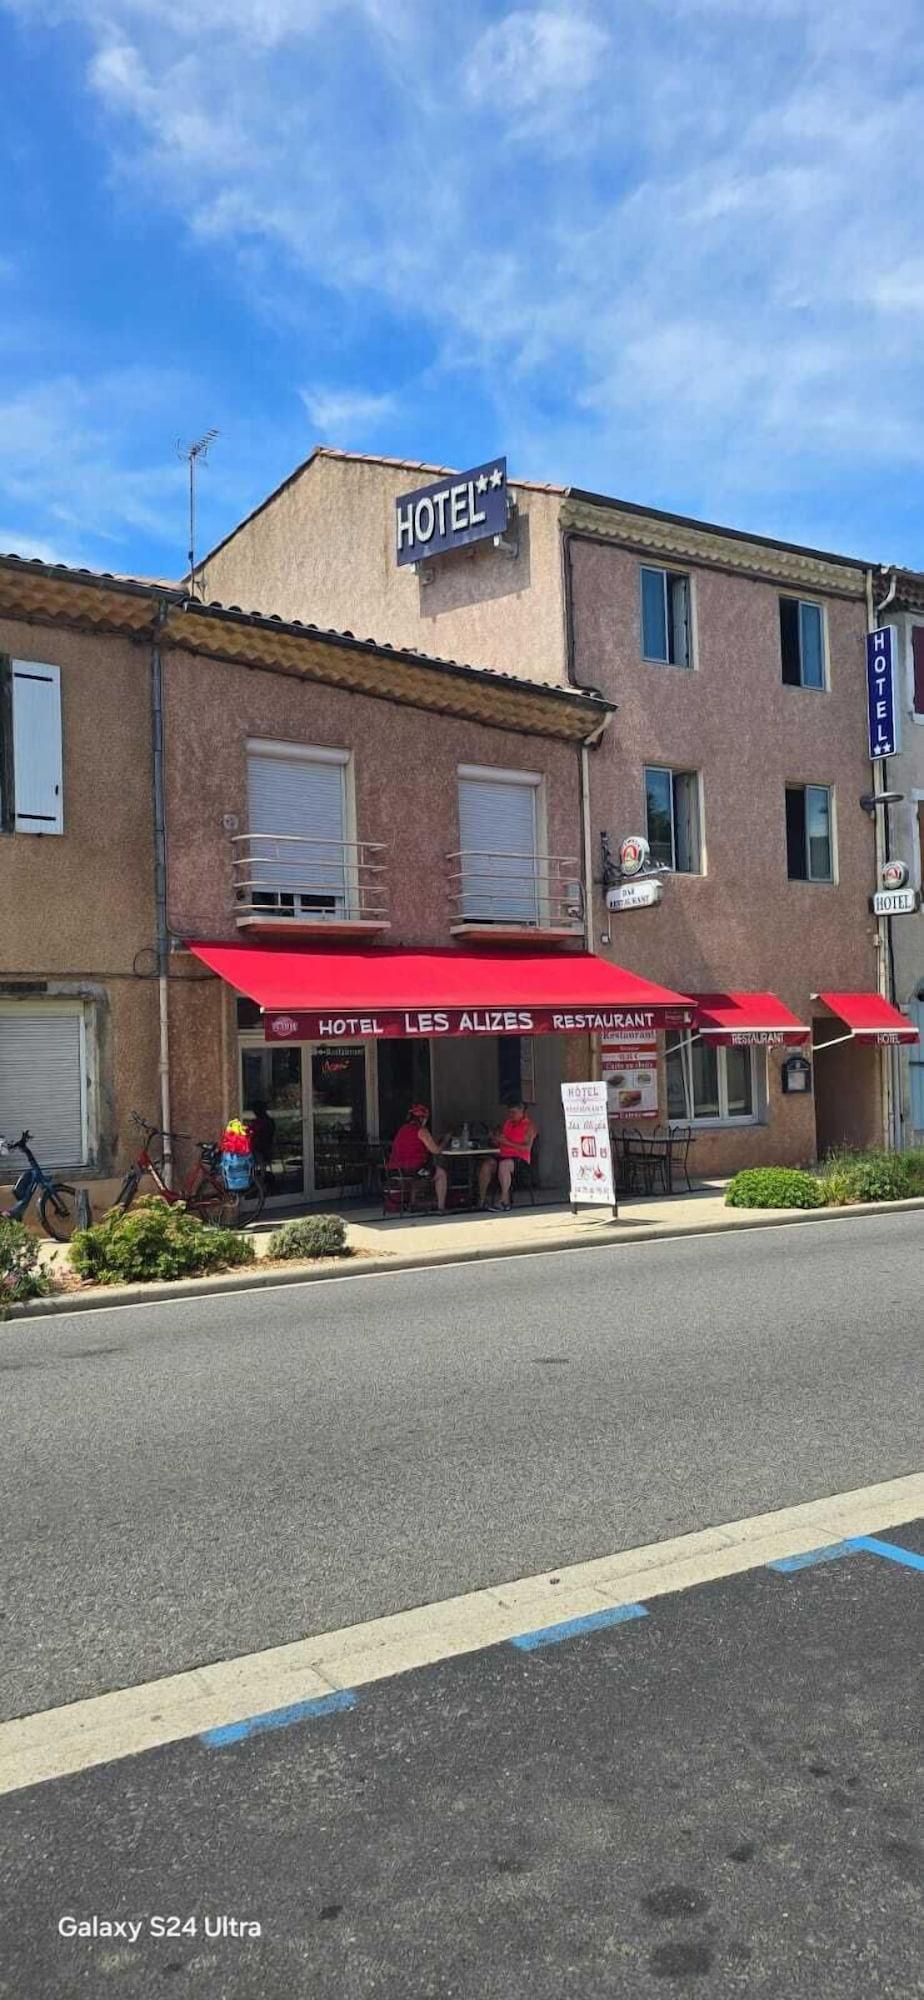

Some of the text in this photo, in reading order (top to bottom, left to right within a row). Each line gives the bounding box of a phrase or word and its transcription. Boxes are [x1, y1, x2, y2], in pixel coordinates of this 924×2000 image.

[397, 481, 486, 550] HOTEL
[874, 632, 888, 742] HOTEL
[876, 895, 912, 911] HOTEL
[319, 1018, 384, 1036] HOTEL
[405, 1013, 450, 1033] LES
[553, 1013, 655, 1029] RESTAURANT
[731, 1032, 785, 1045] RESTAURANT
[877, 1033, 900, 1044] HOTEL
